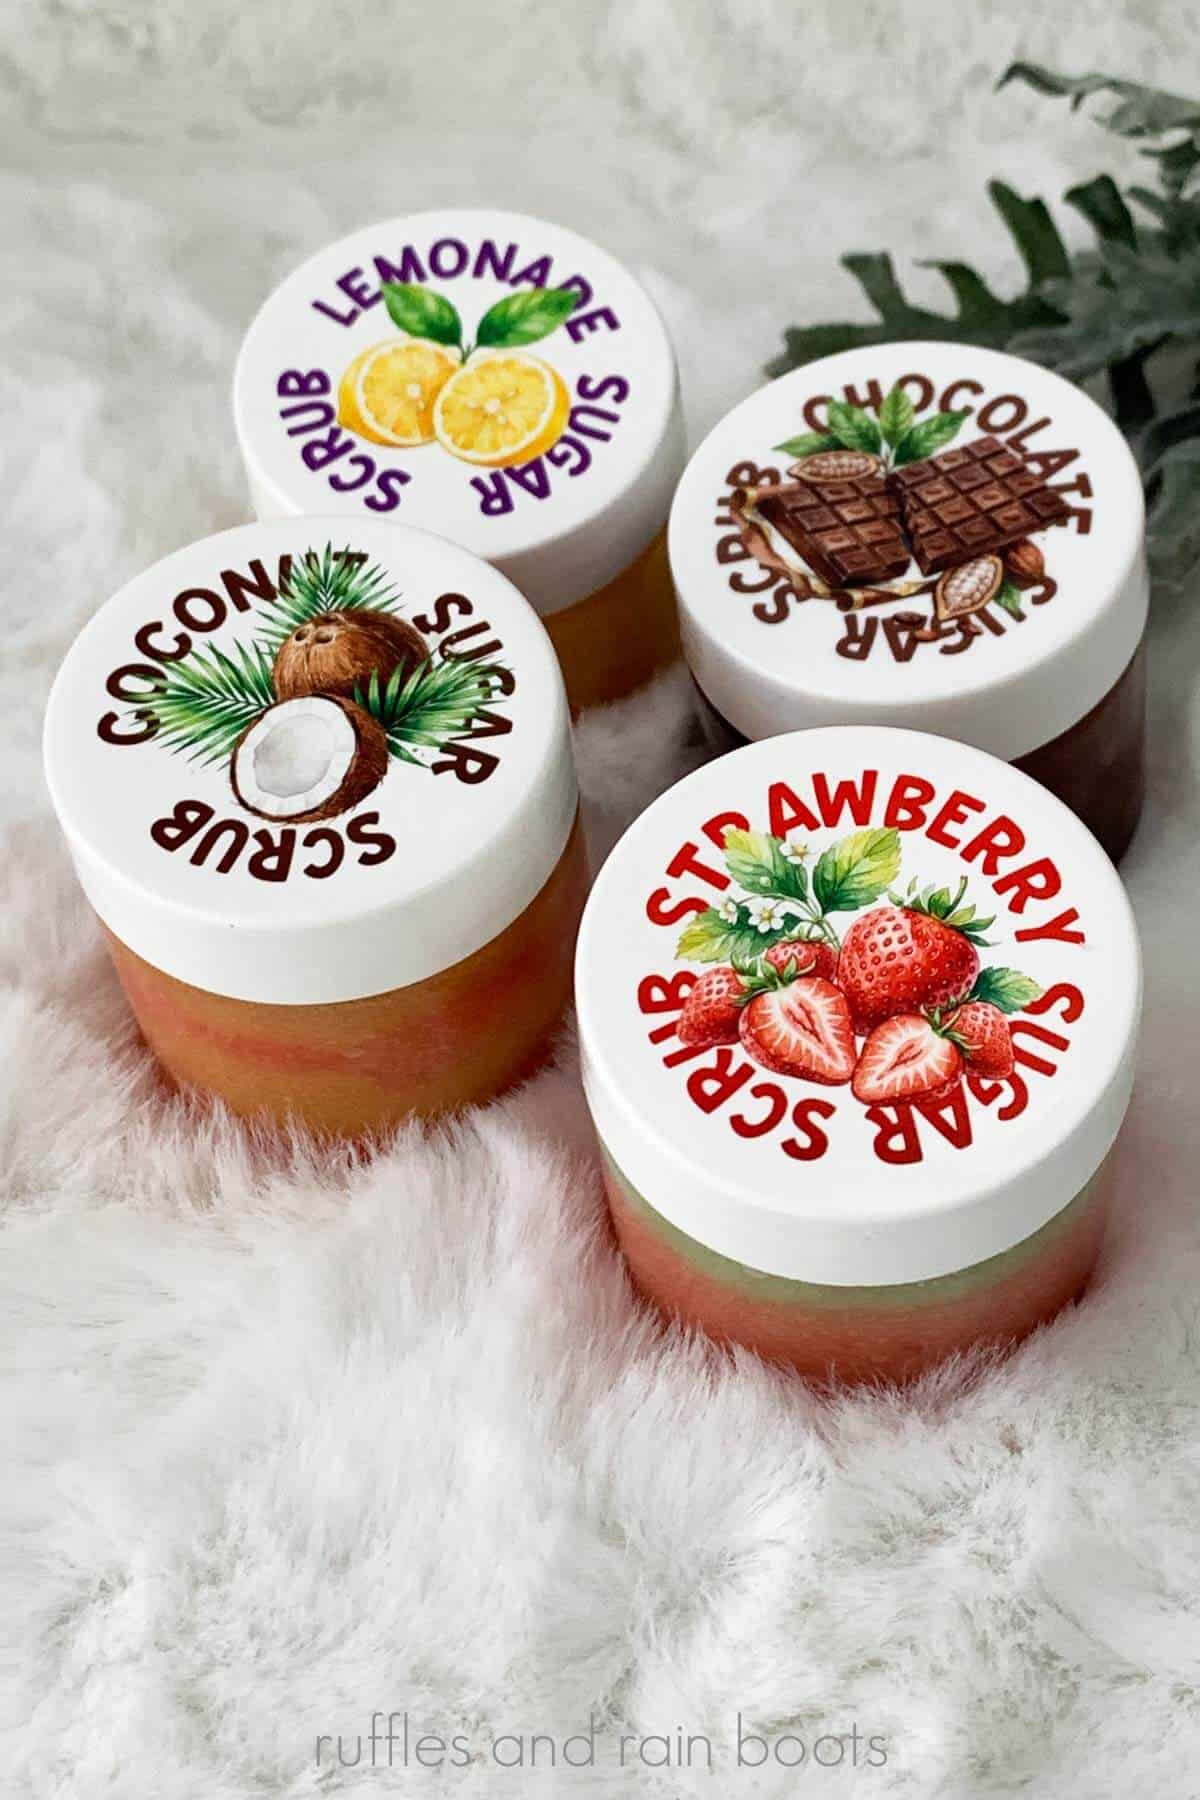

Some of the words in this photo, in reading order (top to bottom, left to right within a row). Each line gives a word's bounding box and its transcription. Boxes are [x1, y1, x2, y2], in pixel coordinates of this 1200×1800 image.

[277, 369, 411, 512] SCRUB
[470, 374, 629, 516] SUGAR
[715, 460, 808, 624] SCRB
[150, 800, 397, 882] SCRUB
[865, 983, 1085, 1164] SUGAR
